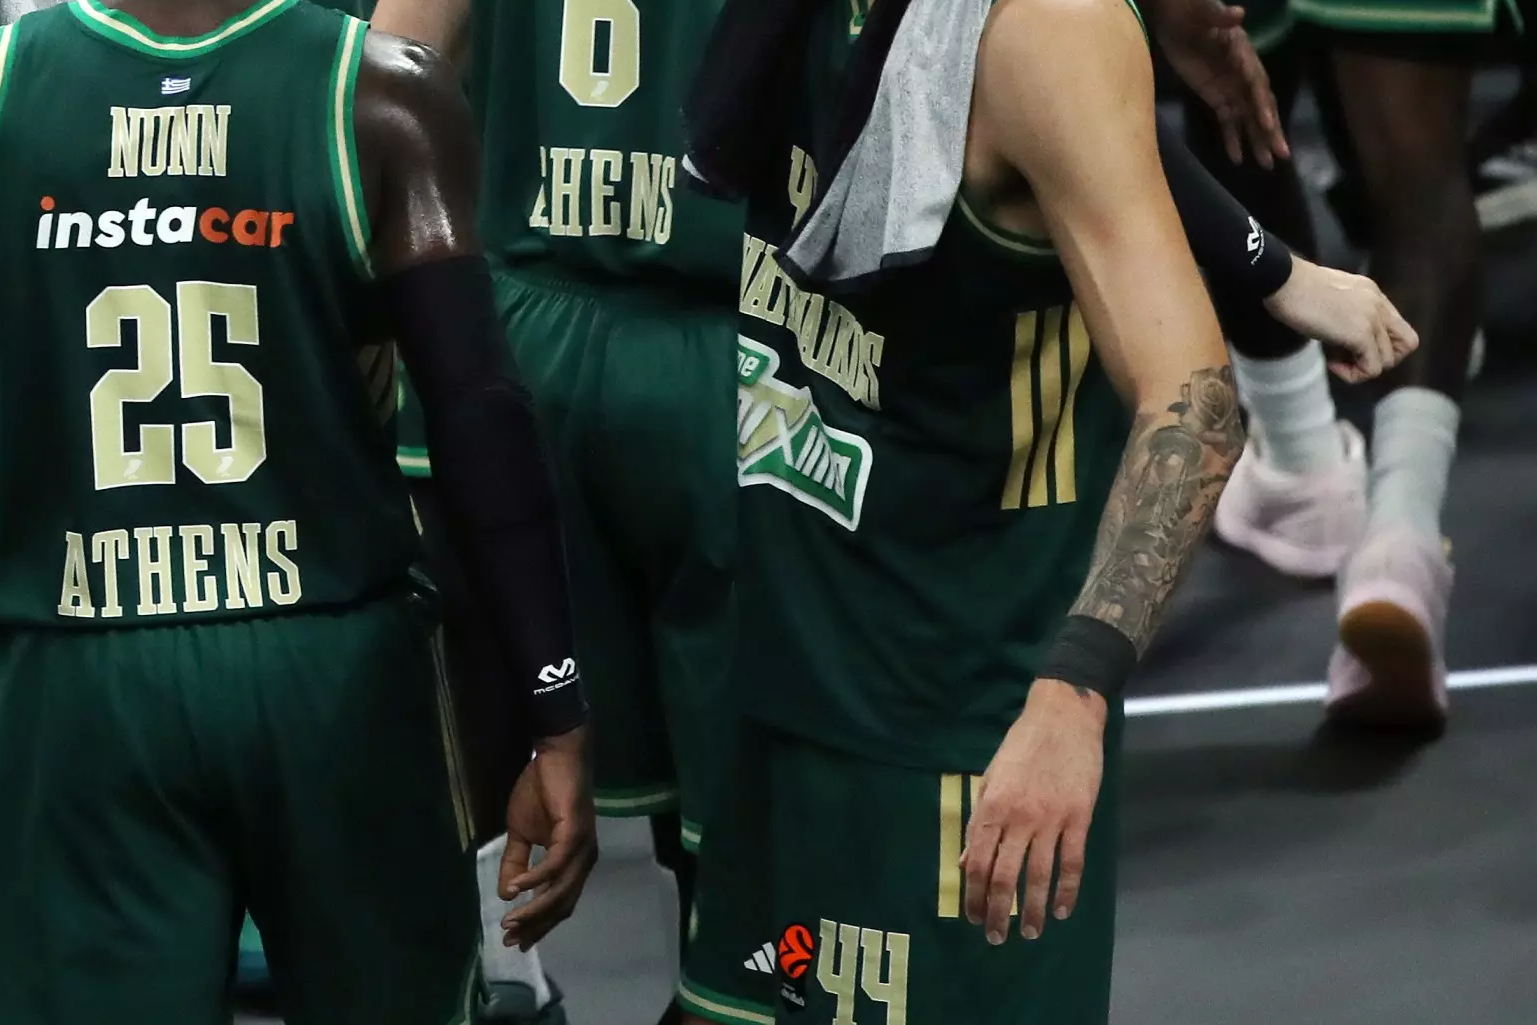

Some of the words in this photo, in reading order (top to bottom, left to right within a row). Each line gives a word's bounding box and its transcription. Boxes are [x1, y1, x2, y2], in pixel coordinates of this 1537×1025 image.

[108, 104, 231, 177] NUNN
[36, 195, 295, 250] instacar
[86, 280, 267, 490] 25
[57, 519, 303, 618] ATHENS
[816, 918, 910, 1025] 44
